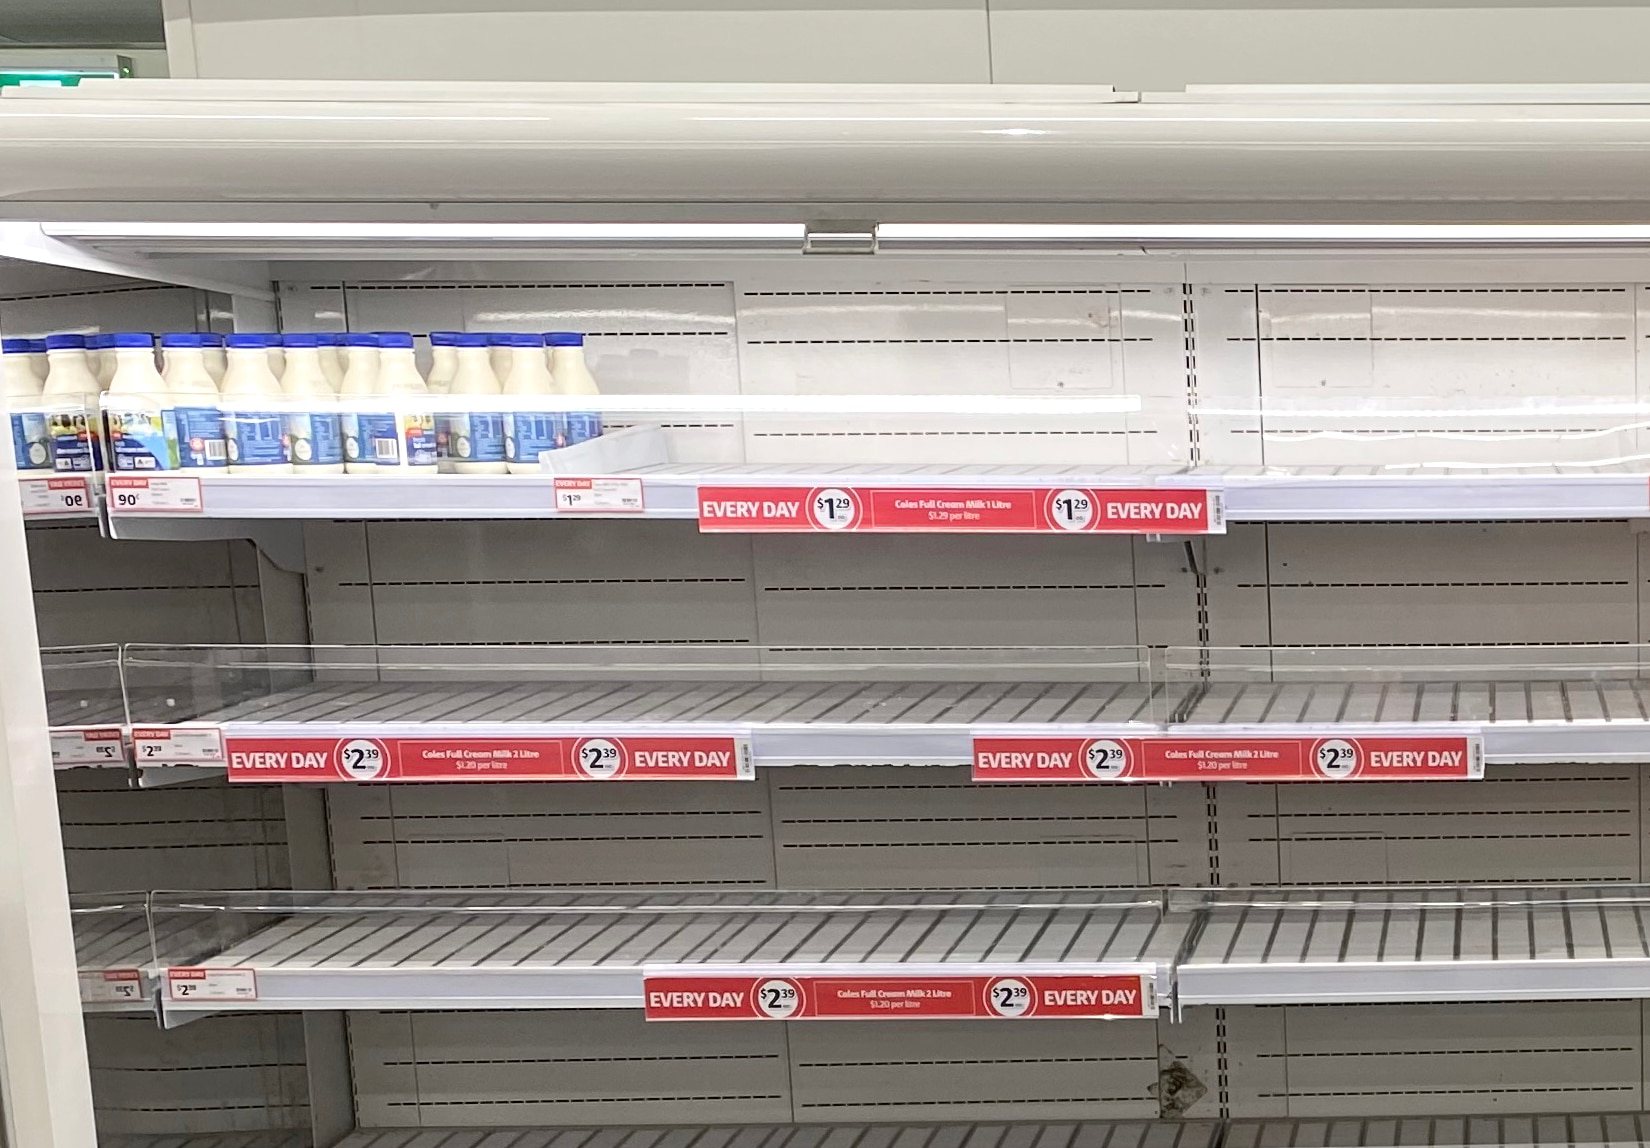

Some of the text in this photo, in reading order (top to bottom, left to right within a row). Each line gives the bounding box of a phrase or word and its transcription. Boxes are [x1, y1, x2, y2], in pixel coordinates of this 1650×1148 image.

[110, 479, 148, 487] EVERY DAY
[702, 501, 800, 518] EVERY DAY
[895, 500, 918, 509] Coles
[919, 500, 935, 509] Full
[936, 500, 964, 509] Cream
[966, 500, 985, 509] Milk
[991, 500, 1012, 509] Litre
[1107, 502, 1202, 519] EVERY DAY
[928, 511, 980, 522] $1.29 per litre
[231, 752, 328, 769] EVERY DAY
[422, 750, 540, 759] Coles Full Cream Milk 2 Litre
[635, 751, 730, 767] EVERY DAY
[978, 752, 1073, 769] EVERY DAY
[1165, 750, 1279, 759] Coles Full Cream Milk 2 Litre
[1371, 751, 1462, 768] EVERY DAY
[456, 760, 508, 772] $1.20 per litre
[1197, 760, 1248, 771] $1.20 per litre
[649, 991, 745, 1008] EVERY DAY
[837, 990, 951, 999] Coles Full Cream Milk 2 Litre
[1044, 989, 1137, 1007] EVERY DAY
[870, 999, 921, 1011] $1.20 per litre
